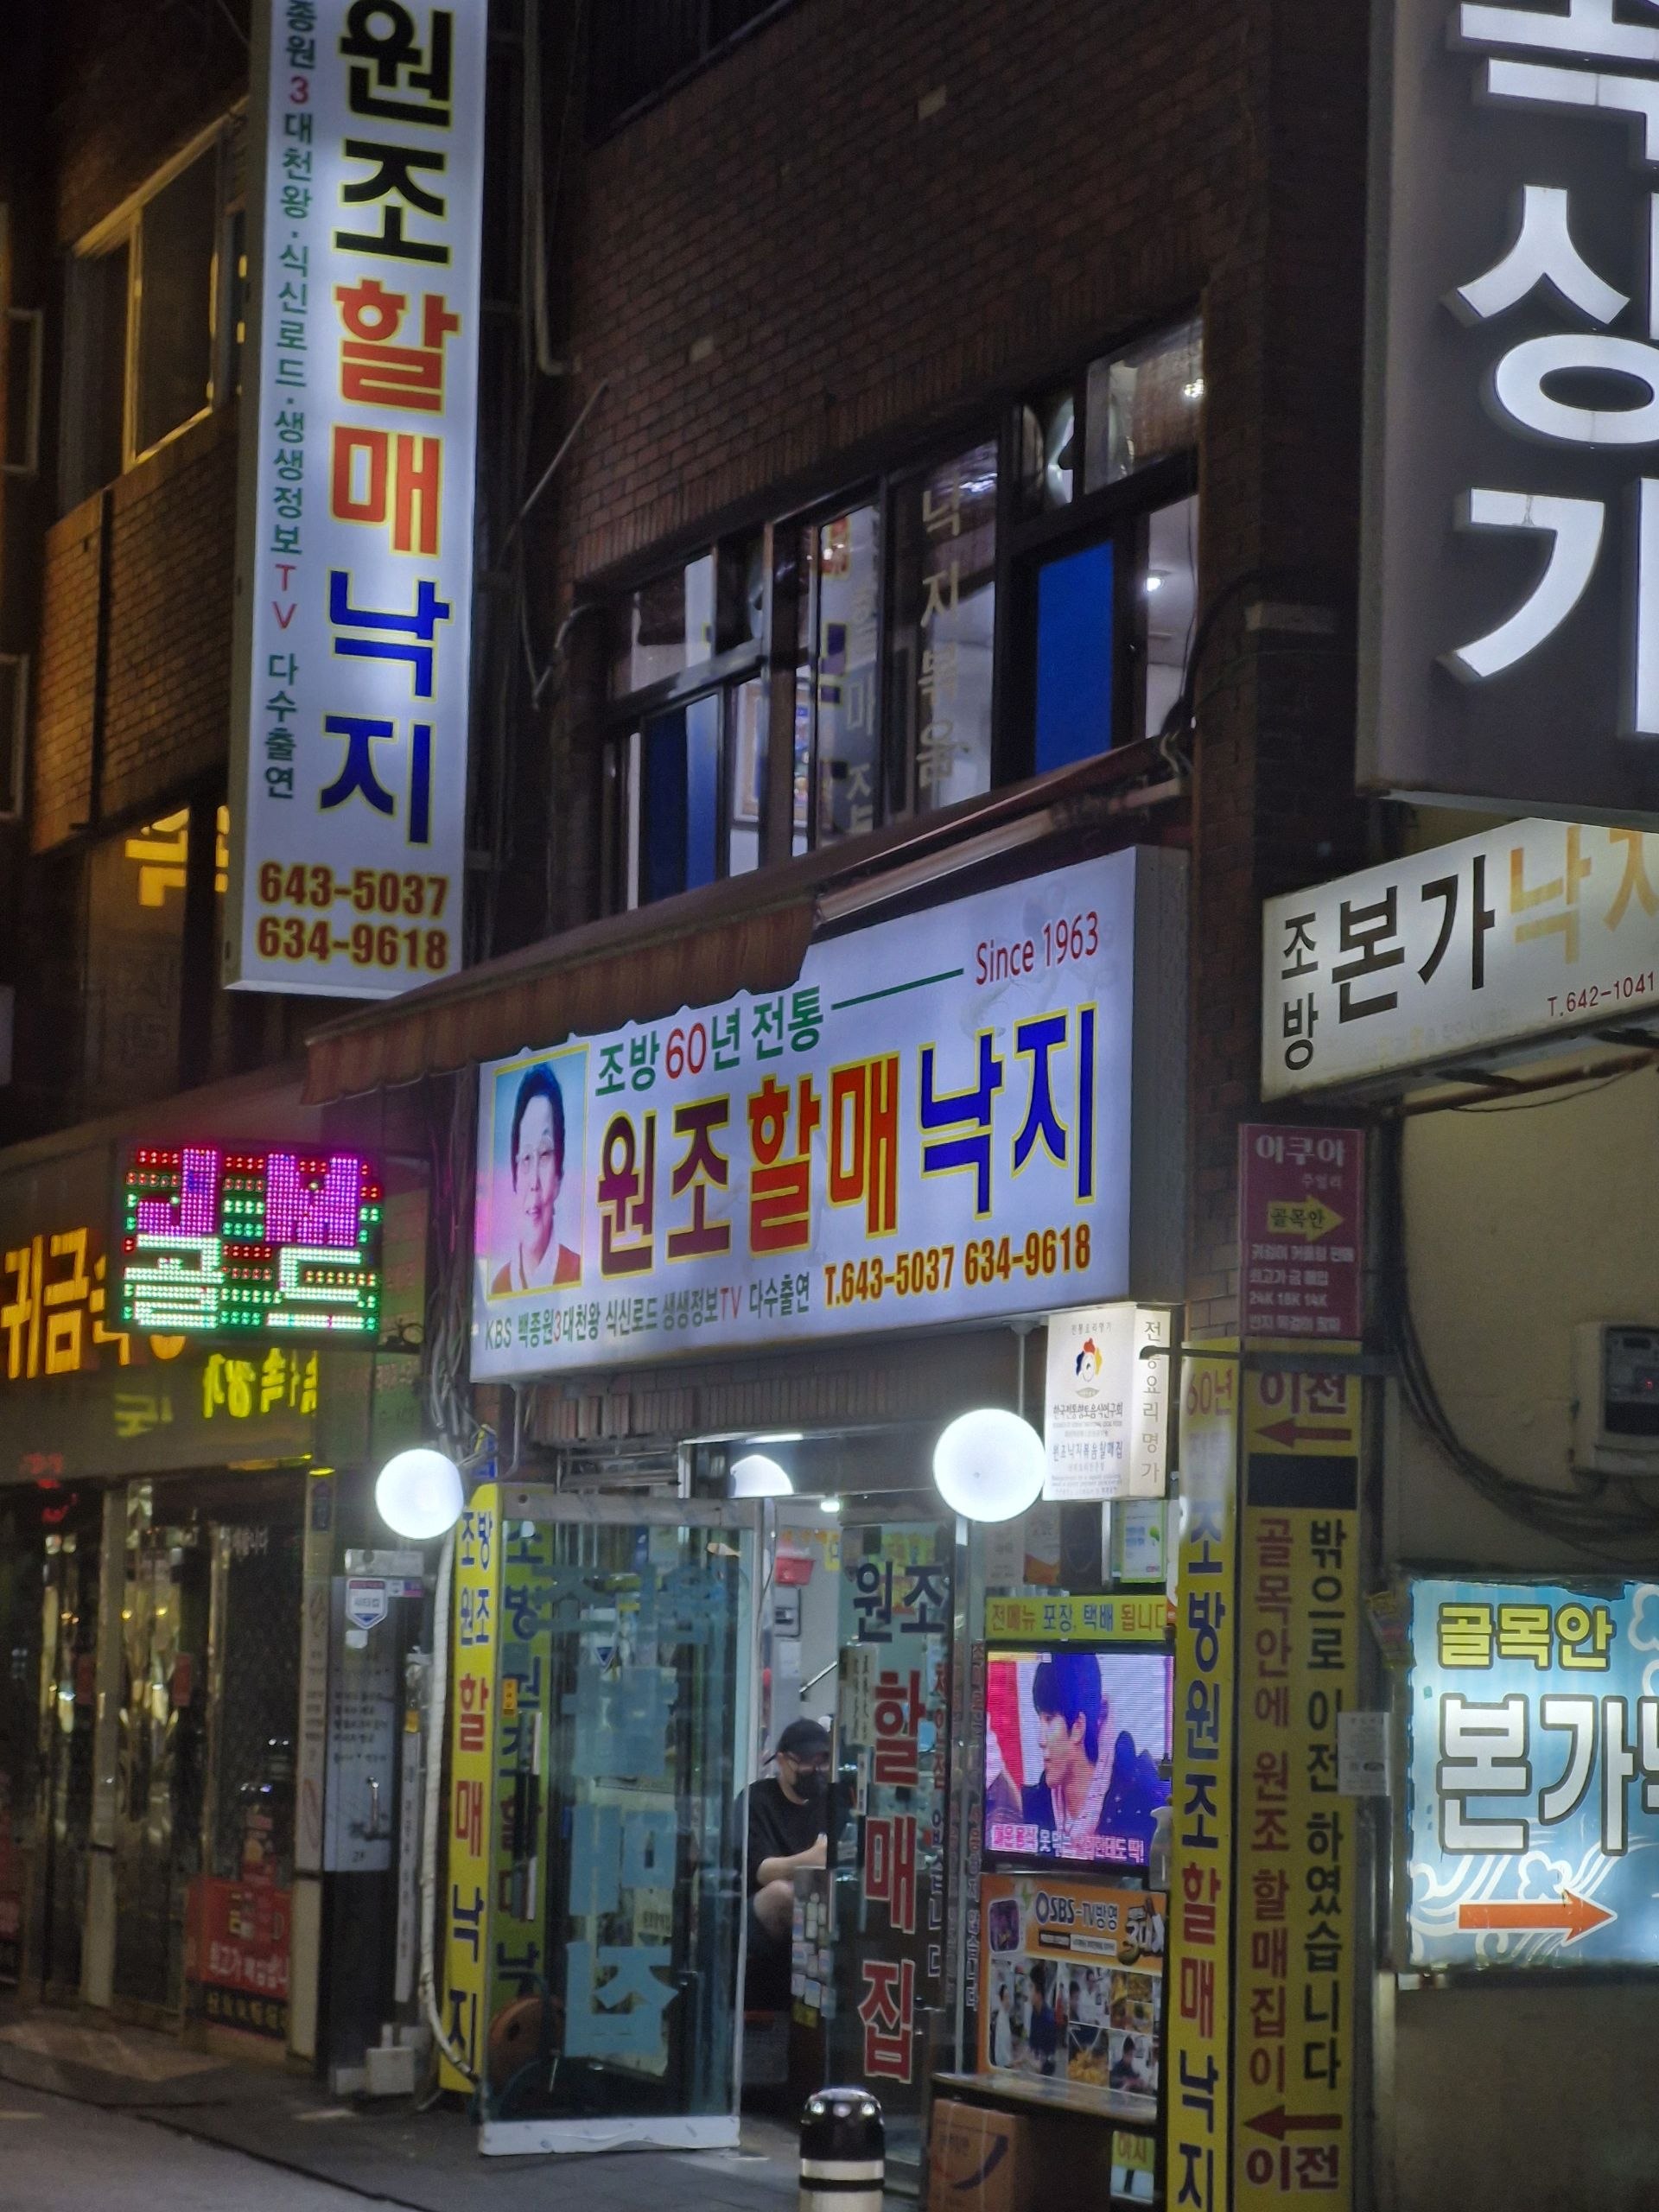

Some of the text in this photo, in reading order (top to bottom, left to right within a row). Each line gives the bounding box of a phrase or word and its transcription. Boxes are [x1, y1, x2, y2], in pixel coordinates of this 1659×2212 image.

[264, 653, 299, 800] 다수출연
[257, 861, 451, 918] 643-5037
[257, 916, 449, 971] 634-9618
[751, 985, 823, 1061] 전통
[975, 936, 1034, 986] Since
[1042, 910, 1100, 968] 1963
[1547, 971, 1656, 1019] T.642-1041
[823, 1222, 1092, 1308] T.643-5037 634-9618
[485, 1317, 512, 1351] KBS
[749, 1271, 810, 1320] 다수출연
[854, 1560, 945, 1643] 원조
[1084, 1603, 1114, 1632] 택배
[1438, 1602, 1617, 1671] 골목안
[1245, 2143, 1340, 2193] 이전
